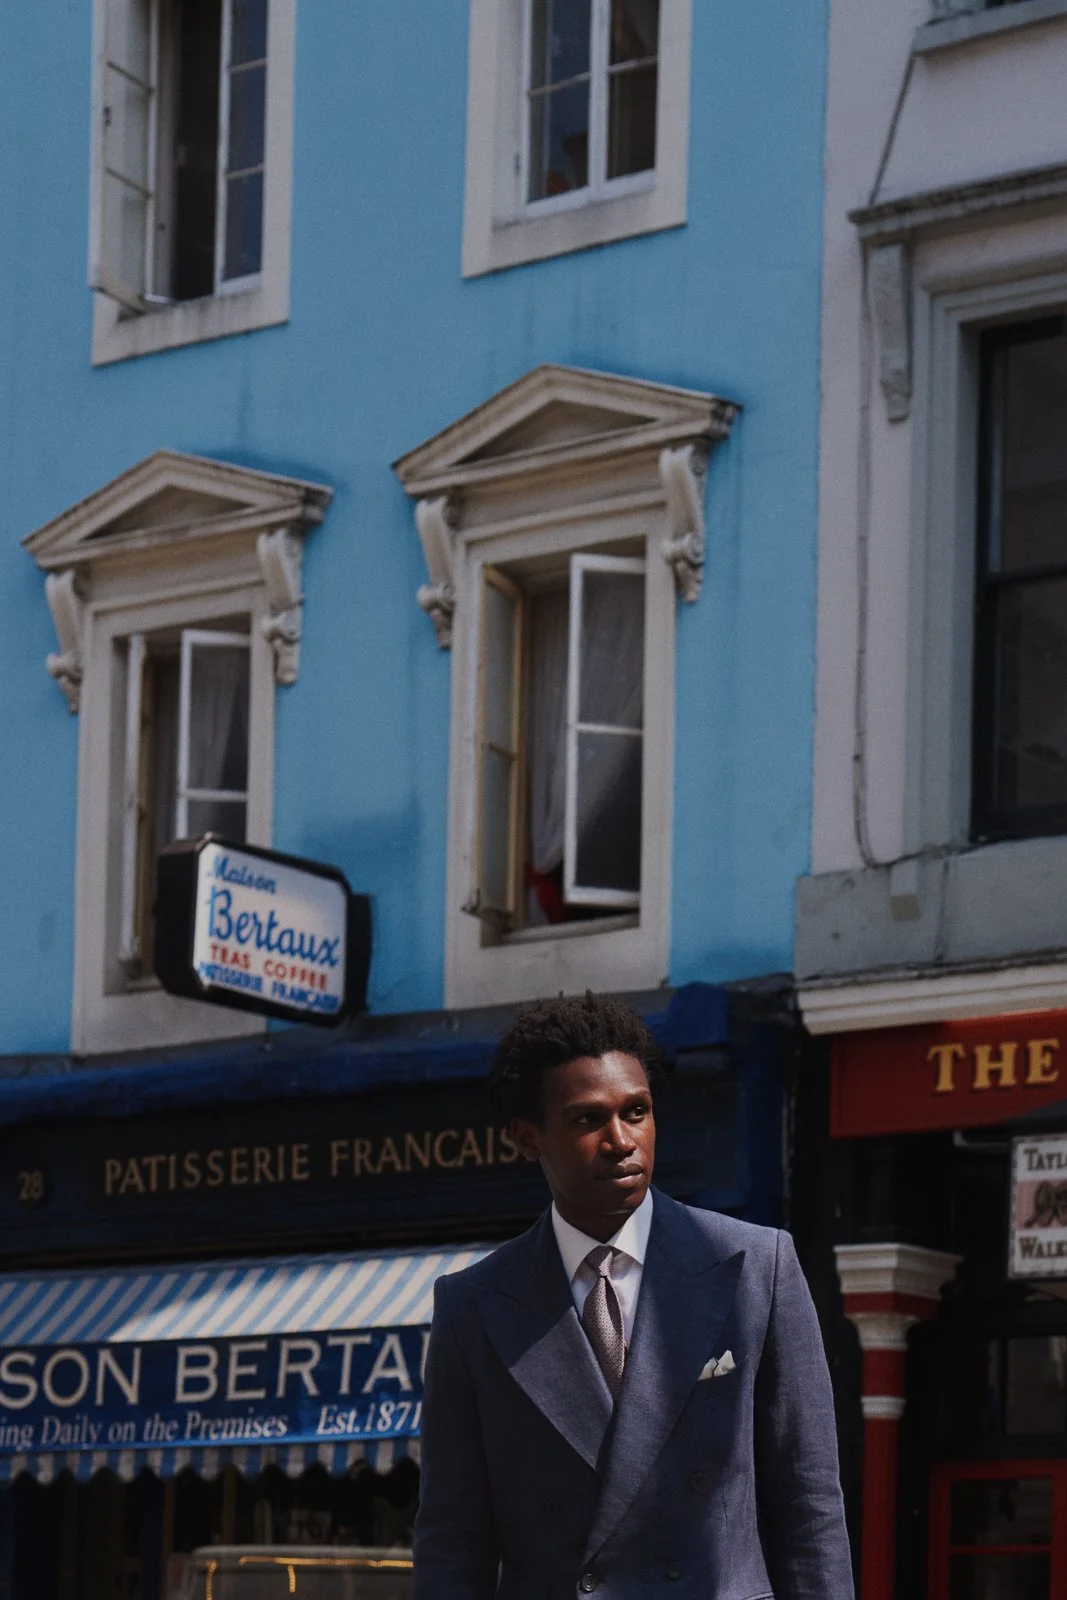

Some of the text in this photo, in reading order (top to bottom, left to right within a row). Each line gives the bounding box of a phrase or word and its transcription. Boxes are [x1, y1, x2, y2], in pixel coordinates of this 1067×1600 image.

[209, 855, 276, 894] Maison
[206, 885, 340, 967] Bertaux
[210, 944, 328, 993] TEAS COFFEE
[927, 1038, 1061, 1092] THE
[18, 1169, 45, 1200] 28
[104, 1126, 524, 1196] PATISSERIE FRANCAIS
[0, 1347, 141, 1410] SON
[40, 1413, 103, 1449] Daily
[108, 1419, 135, 1443] on
[144, 1412, 178, 1441] the
[185, 1409, 288, 1440] Premises
